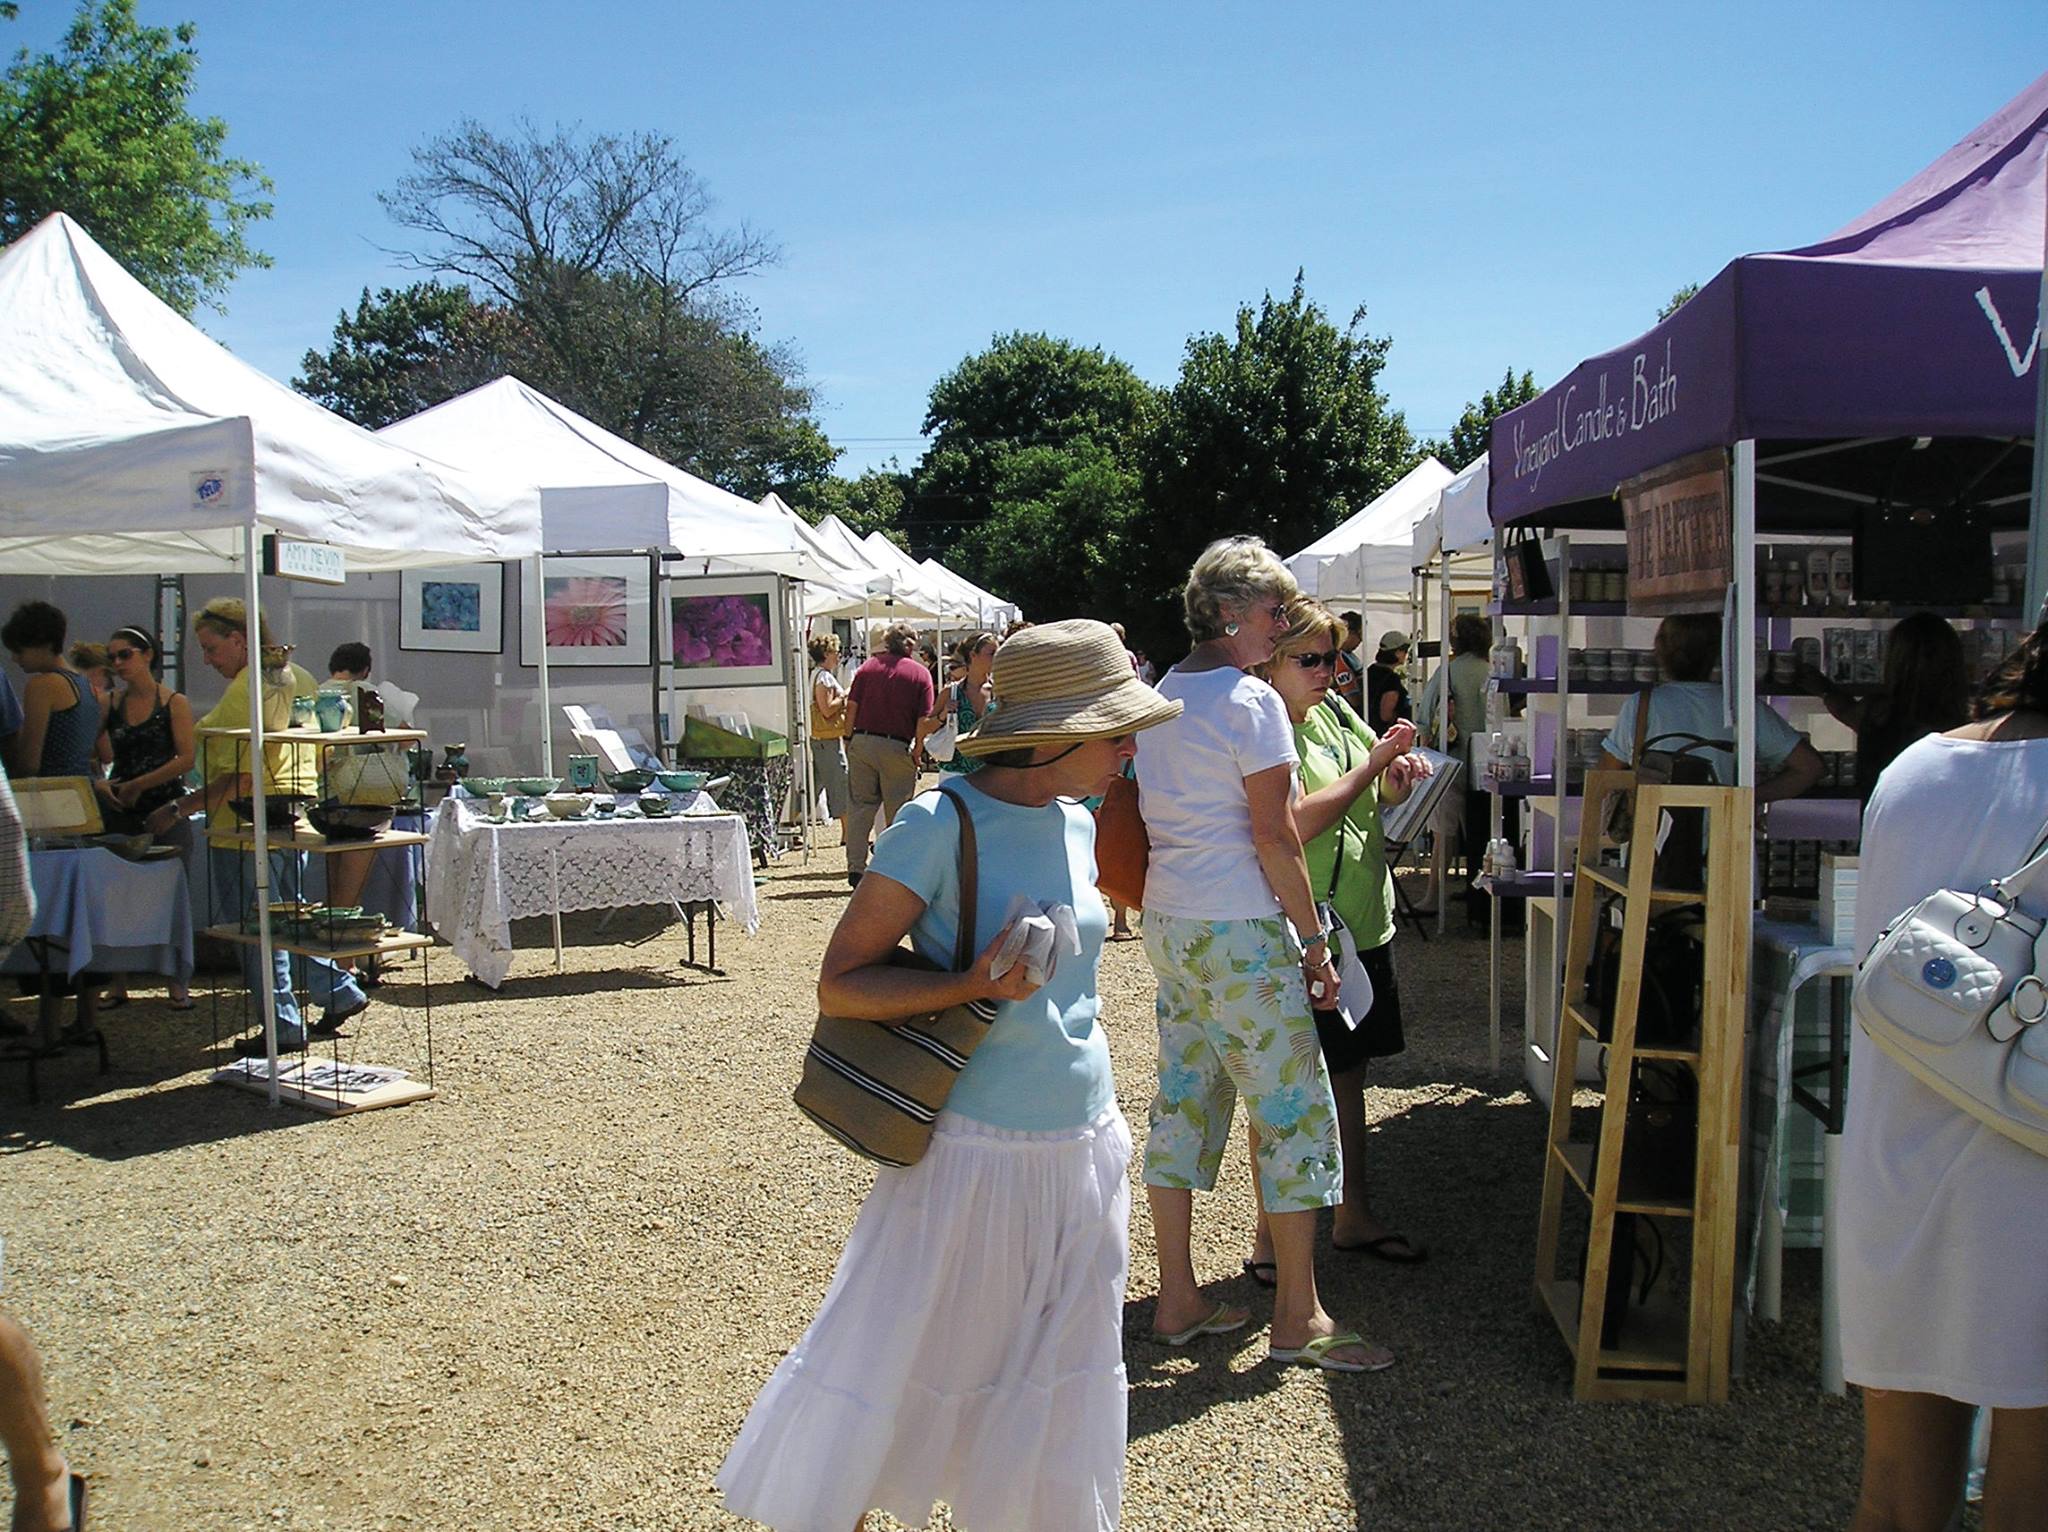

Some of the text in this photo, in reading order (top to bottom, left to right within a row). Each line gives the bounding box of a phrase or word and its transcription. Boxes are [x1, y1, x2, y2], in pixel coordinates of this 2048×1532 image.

[1513, 397, 1561, 493] Vineyard
[1562, 372, 1614, 451] Candle
[1631, 337, 1677, 430] Bath
[286, 543, 307, 561] AMY
